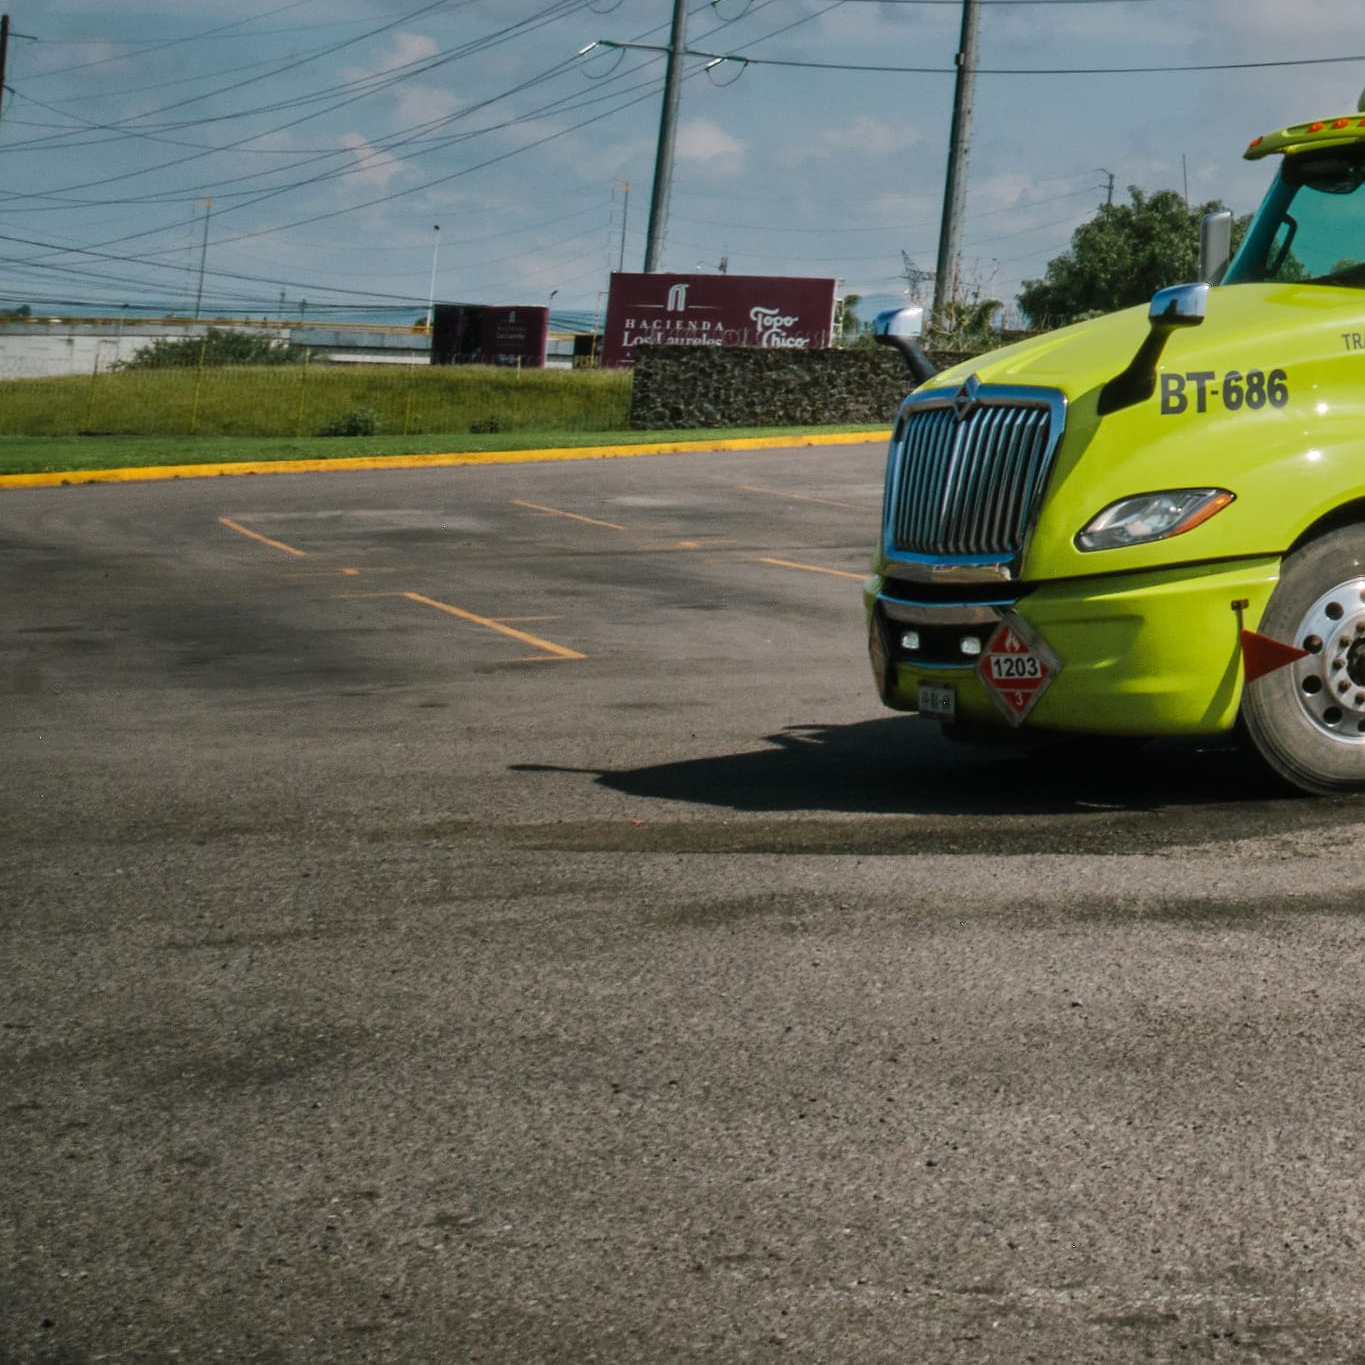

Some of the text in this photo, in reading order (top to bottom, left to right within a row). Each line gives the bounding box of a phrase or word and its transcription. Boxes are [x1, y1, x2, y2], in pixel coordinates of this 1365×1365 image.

[625, 318, 725, 332] HACIENDA
[750, 306, 799, 332] Topo
[622, 332, 724, 347] Los Laureles
[1160, 369, 1289, 415] BT-686
[993, 657, 1039, 678] 1203
[1014, 690, 1023, 707] 3
